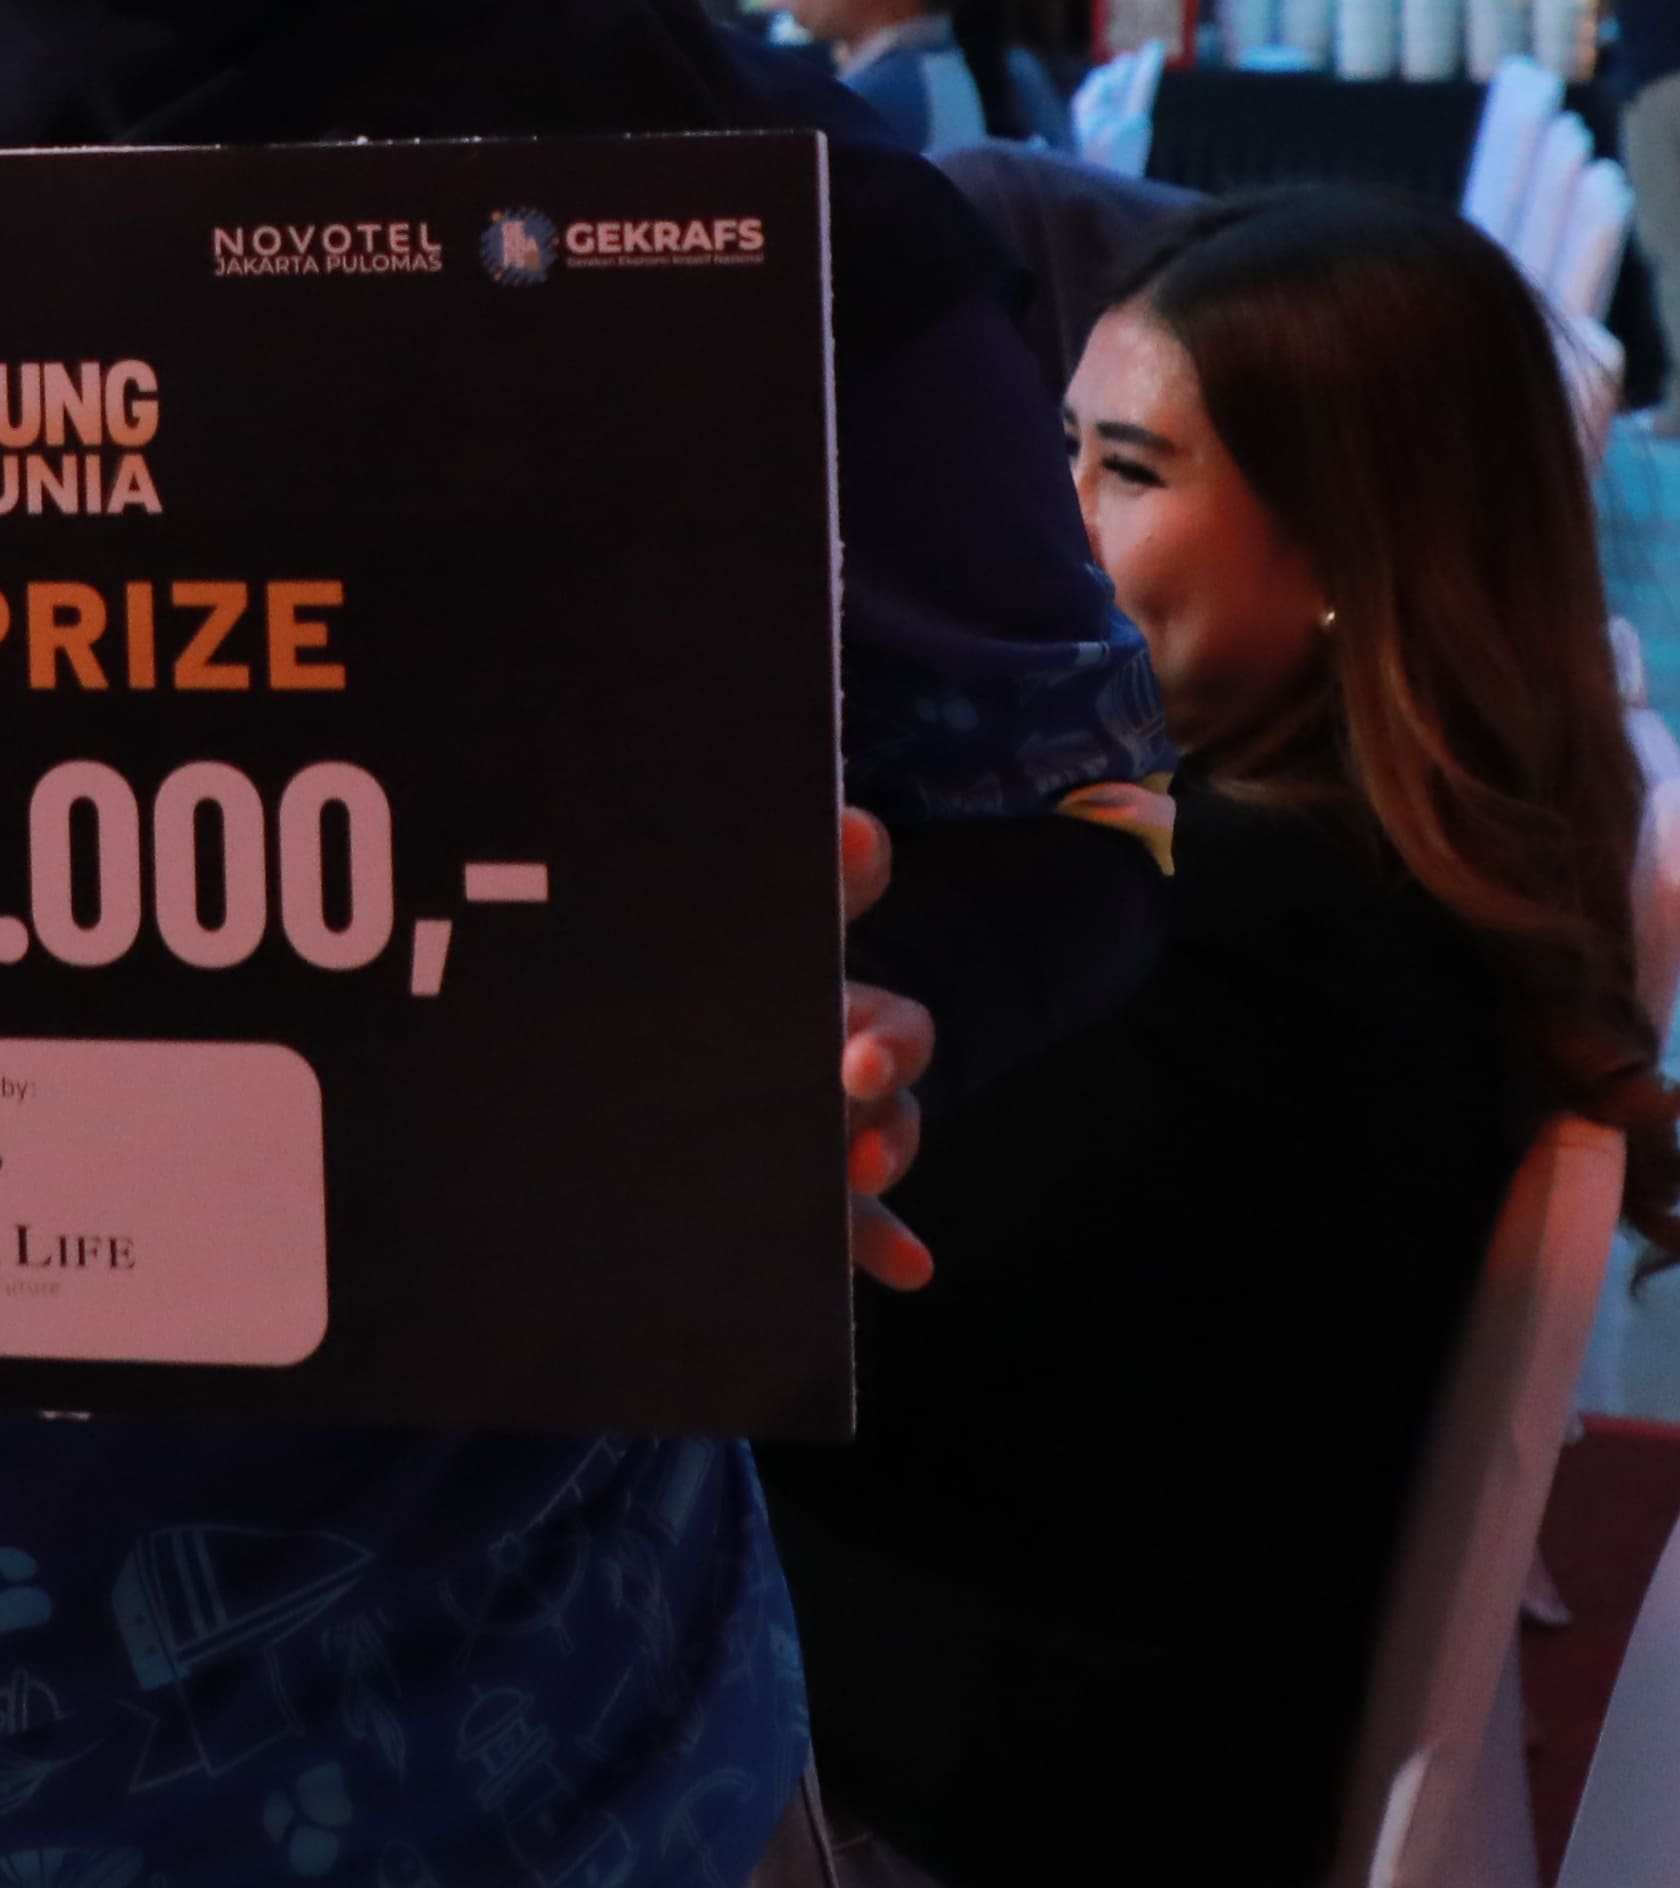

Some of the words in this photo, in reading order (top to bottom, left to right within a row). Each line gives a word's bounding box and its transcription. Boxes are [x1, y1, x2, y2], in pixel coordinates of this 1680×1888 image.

[213, 222, 443, 257] NOVOTEL
[566, 218, 766, 254] GEKRAFS
[213, 256, 321, 278] JAKARTA
[325, 254, 443, 275] PULOMAS
[17, 1224, 136, 1271] LIFE
